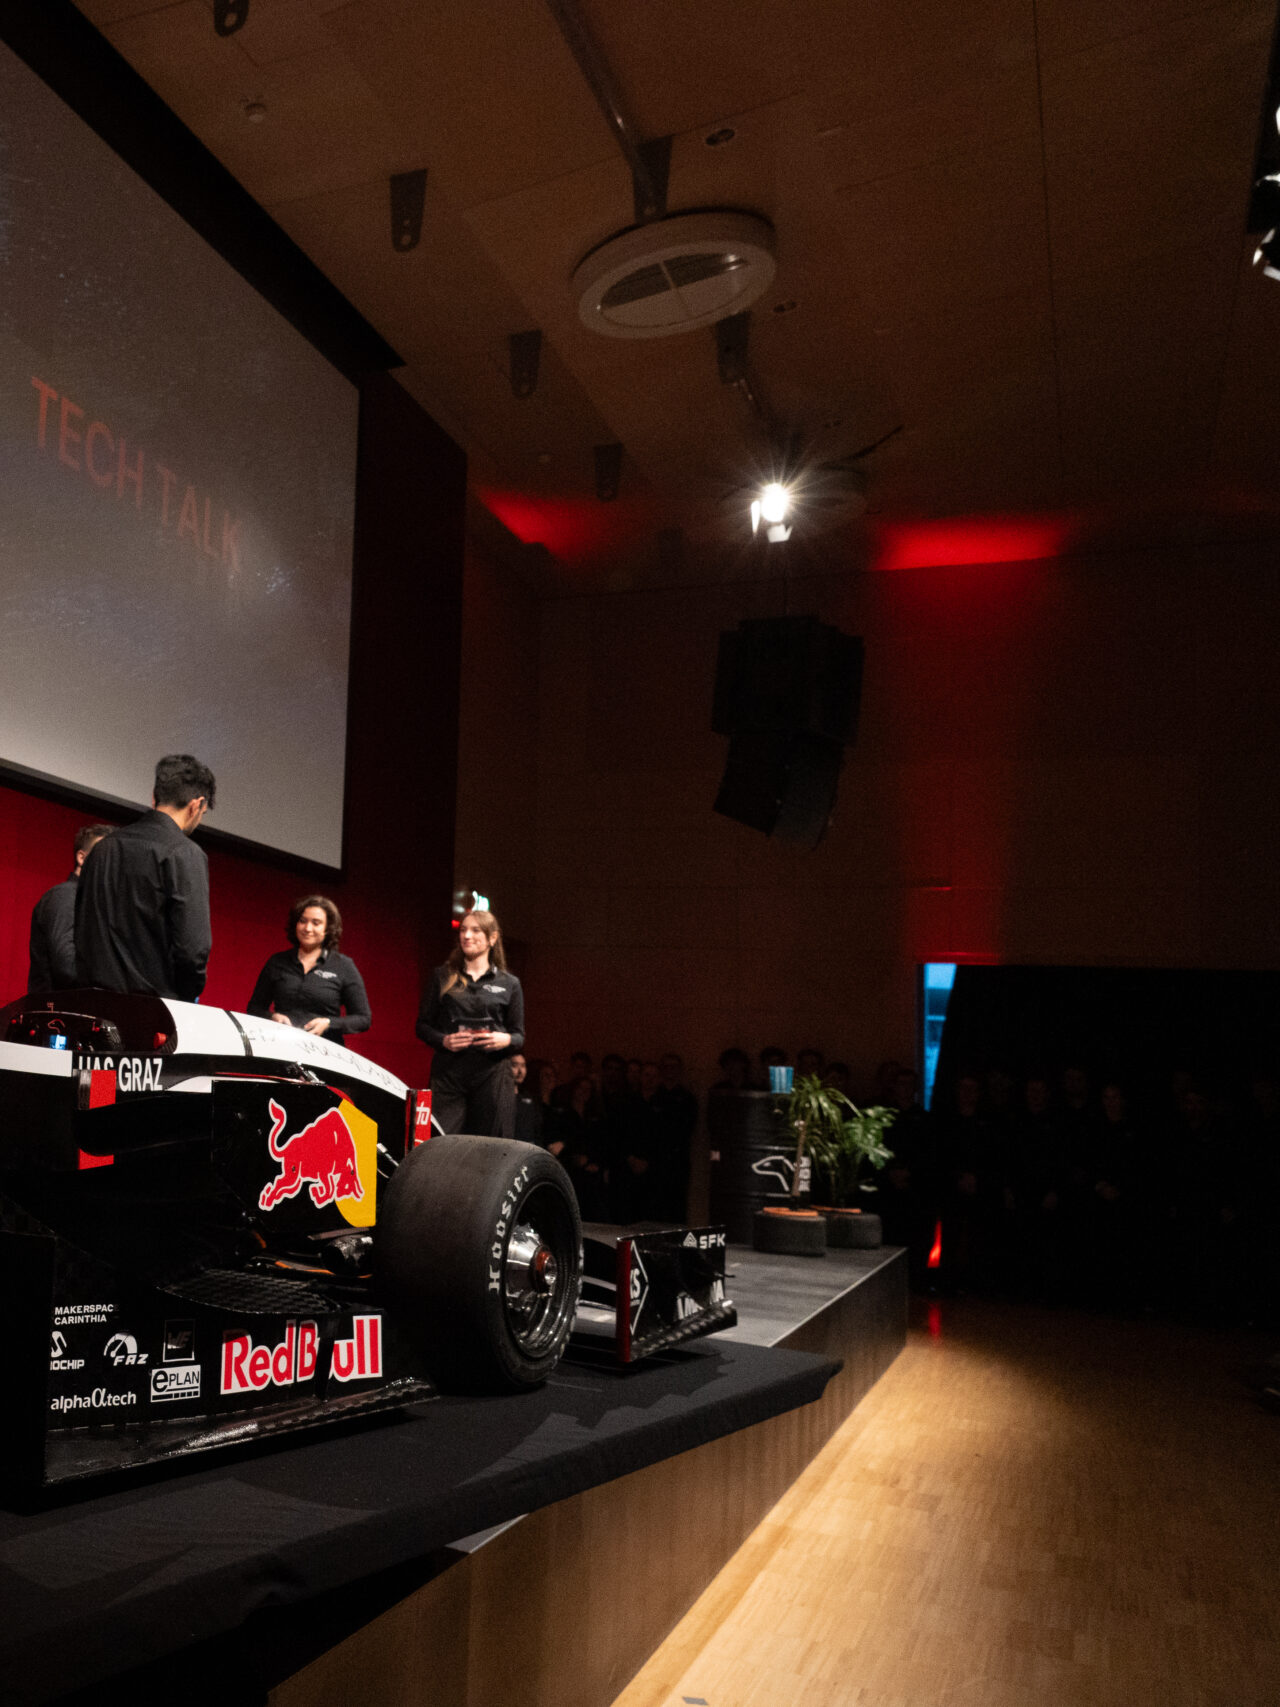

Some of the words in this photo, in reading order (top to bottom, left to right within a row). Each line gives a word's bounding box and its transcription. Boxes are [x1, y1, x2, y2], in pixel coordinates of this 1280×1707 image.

[32, 376, 144, 512] TECH
[154, 463, 245, 577] TALK
[118, 1057, 163, 1092] GRAZ
[699, 1233, 727, 1250] SFK
[54, 1313, 108, 1326] CARINTHIA
